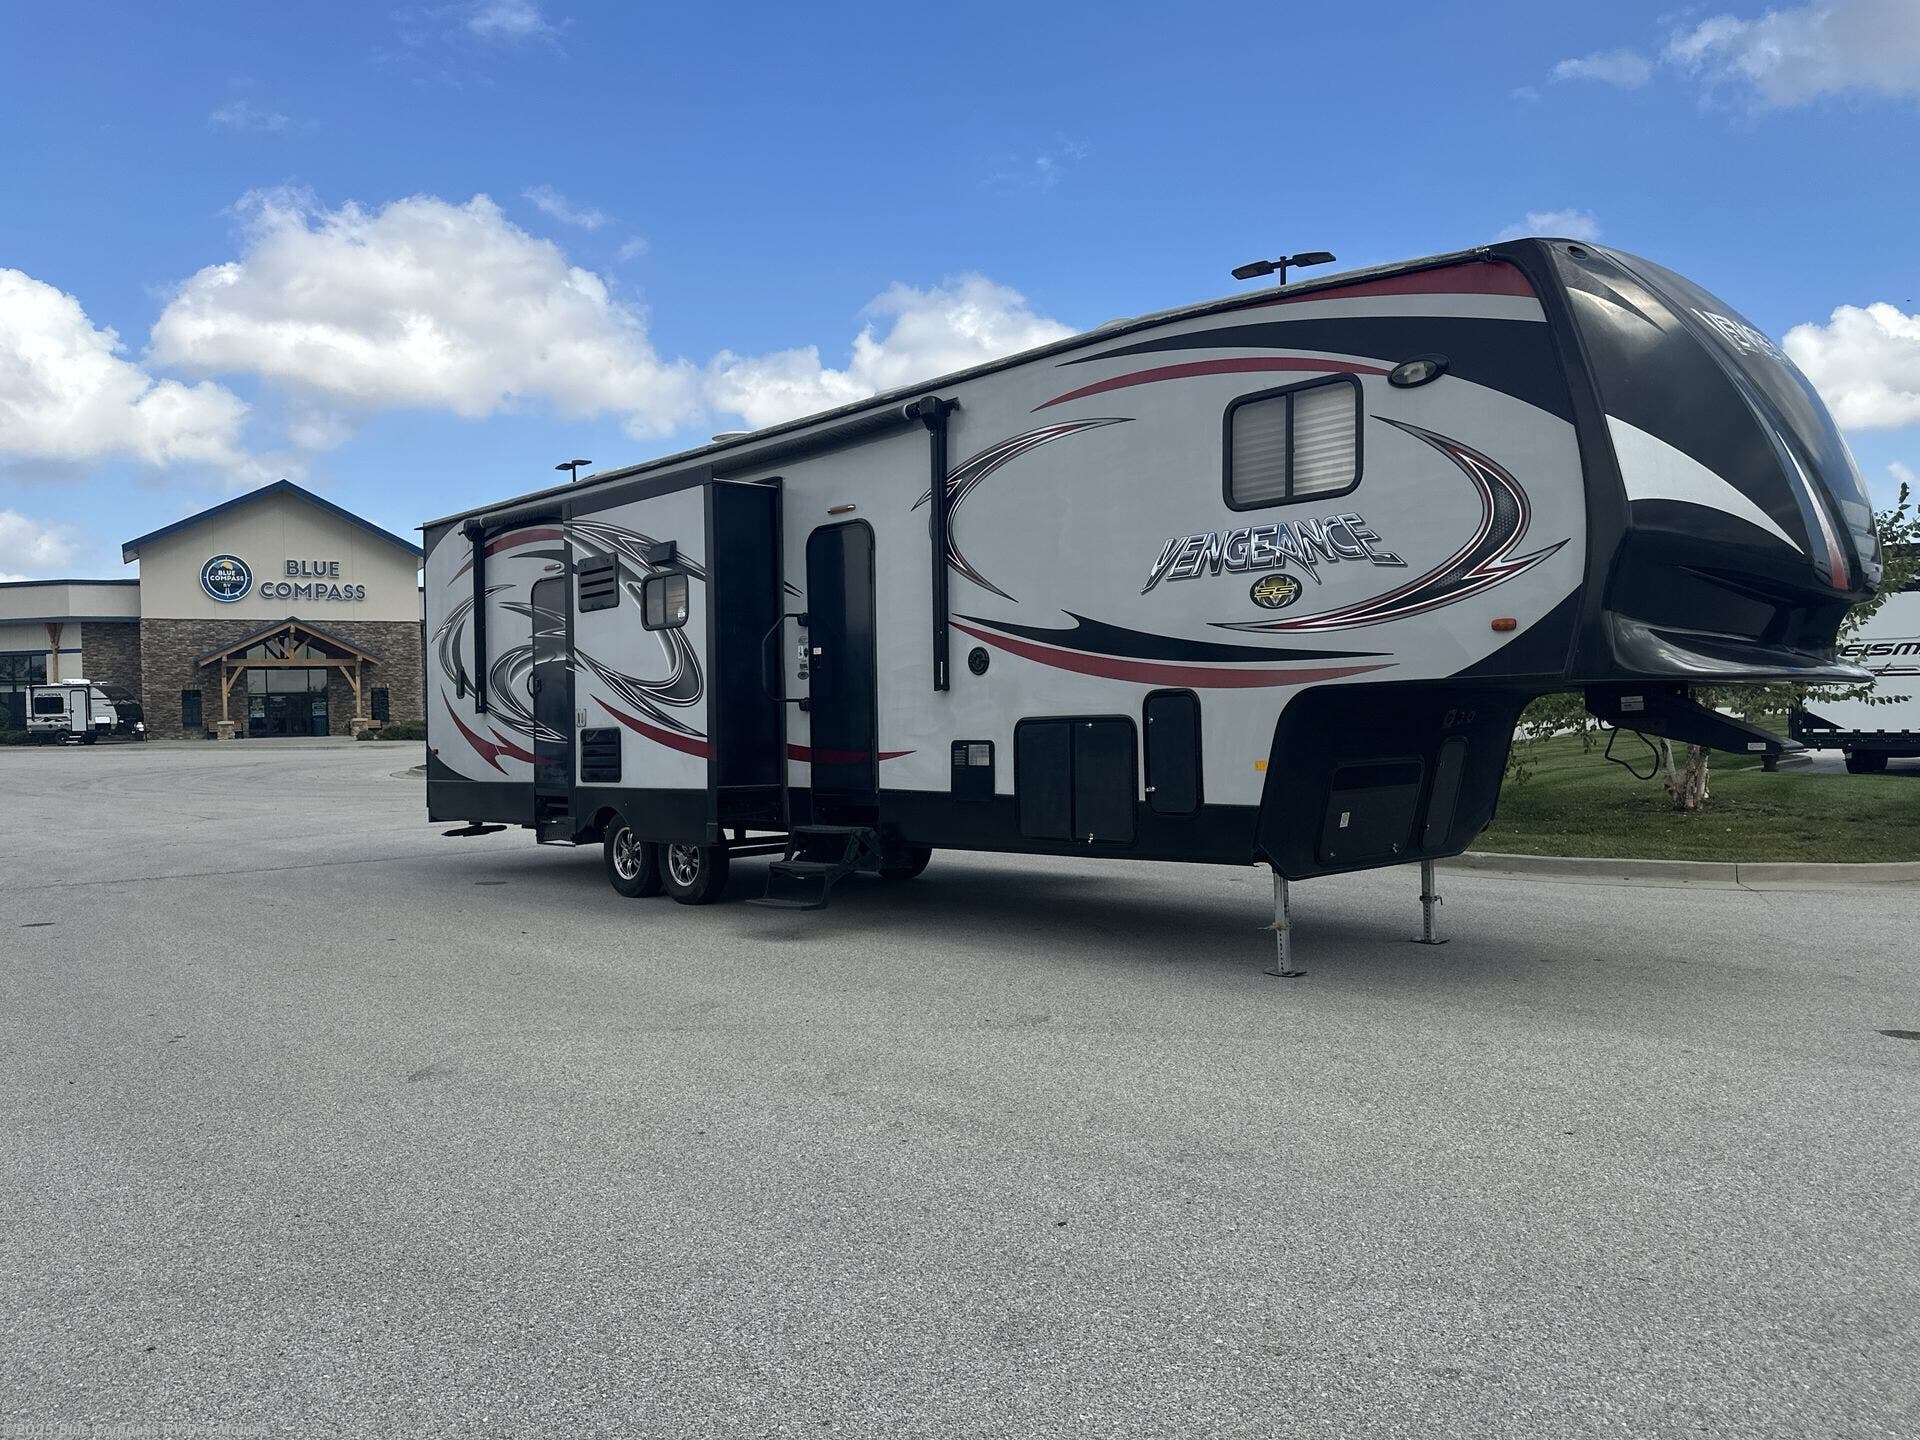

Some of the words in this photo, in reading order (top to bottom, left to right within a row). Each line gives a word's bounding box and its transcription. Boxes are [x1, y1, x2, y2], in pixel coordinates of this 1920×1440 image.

[1141, 512, 1408, 594] VENGEANCE
[286, 560, 340, 578] BLUE
[260, 581, 367, 600] COMPASS
